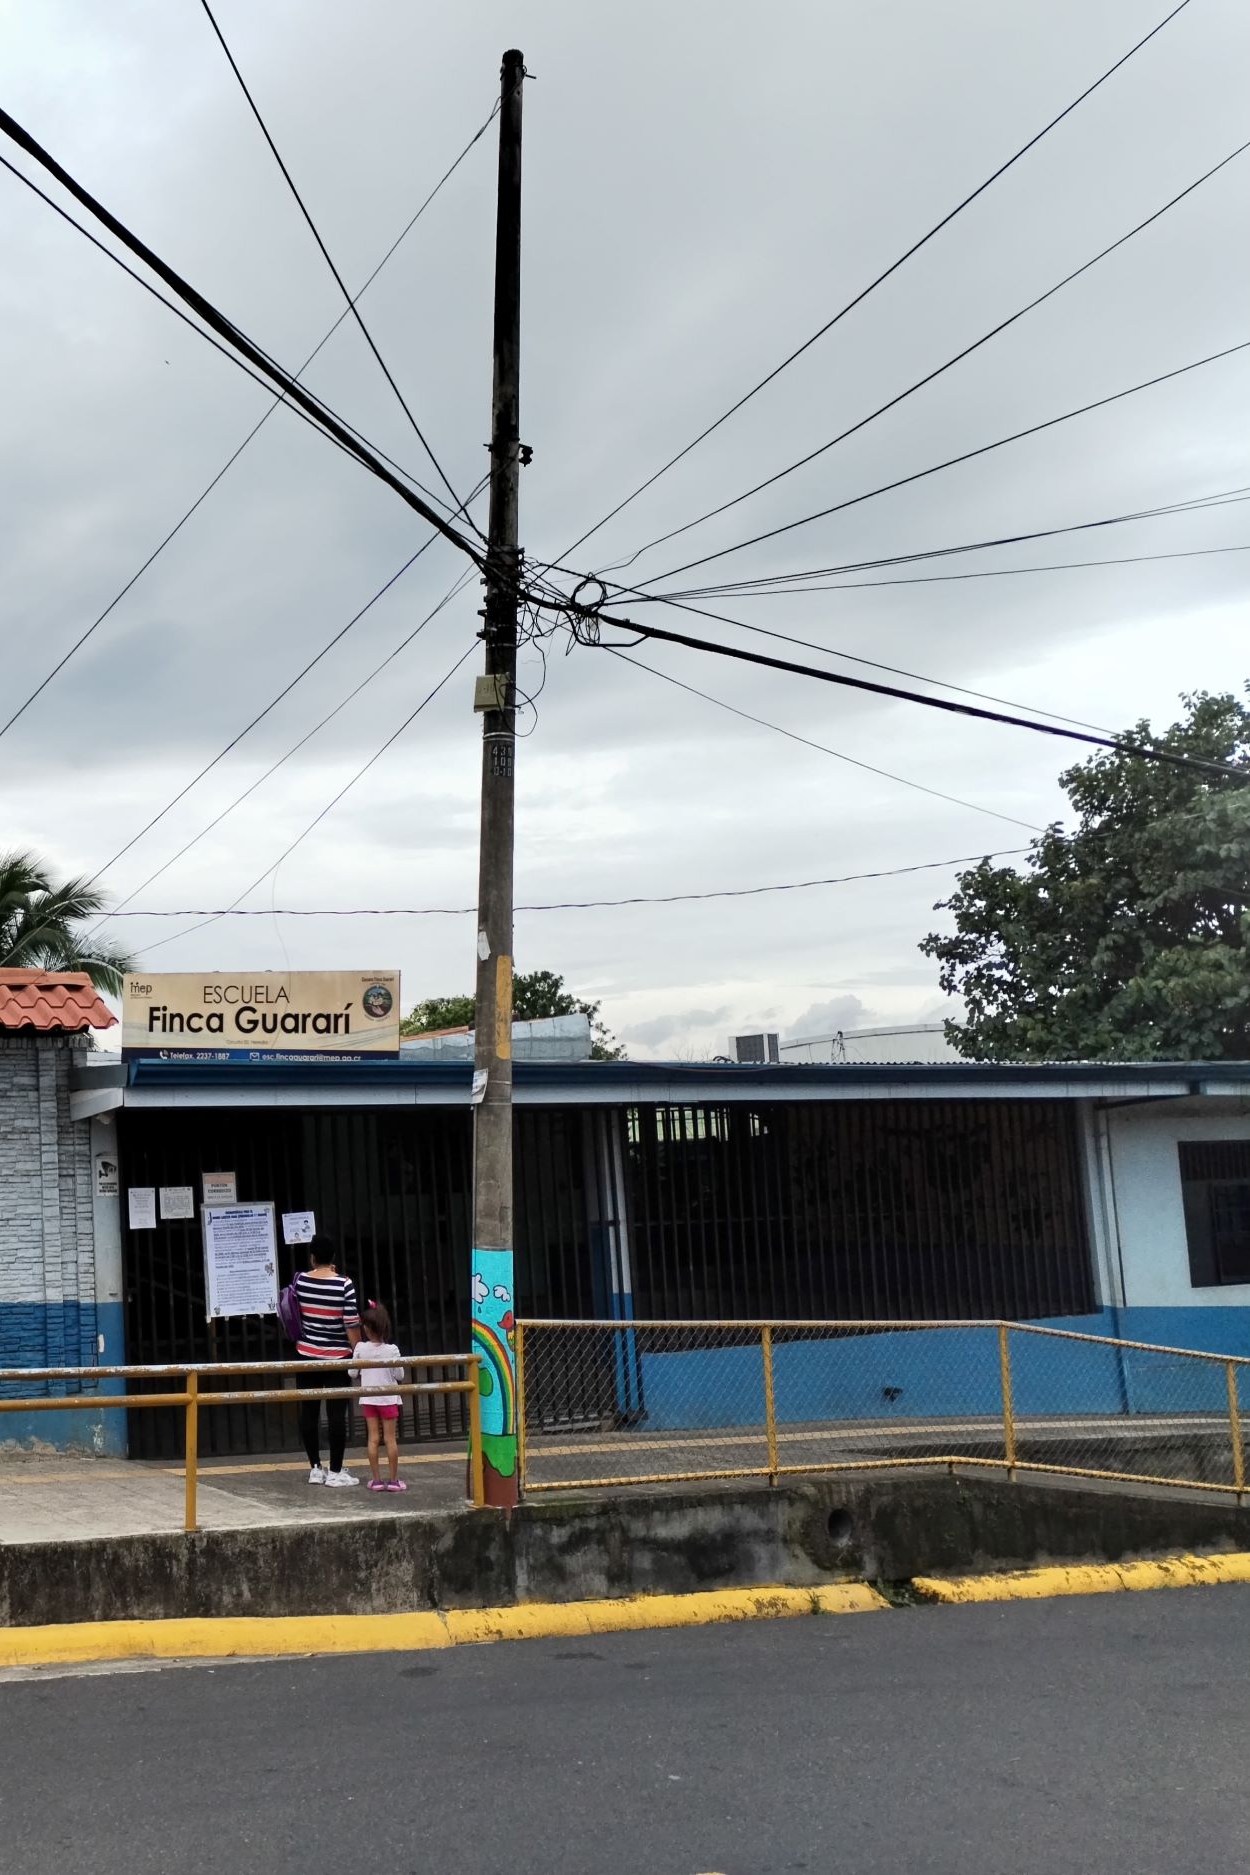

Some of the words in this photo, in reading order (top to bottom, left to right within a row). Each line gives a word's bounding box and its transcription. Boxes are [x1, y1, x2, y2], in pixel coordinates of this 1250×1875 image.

[130, 982, 153, 995] mep
[203, 985, 290, 1004] ESCUELA
[148, 1005, 224, 1033] Finca
[234, 1003, 354, 1035] Guararí
